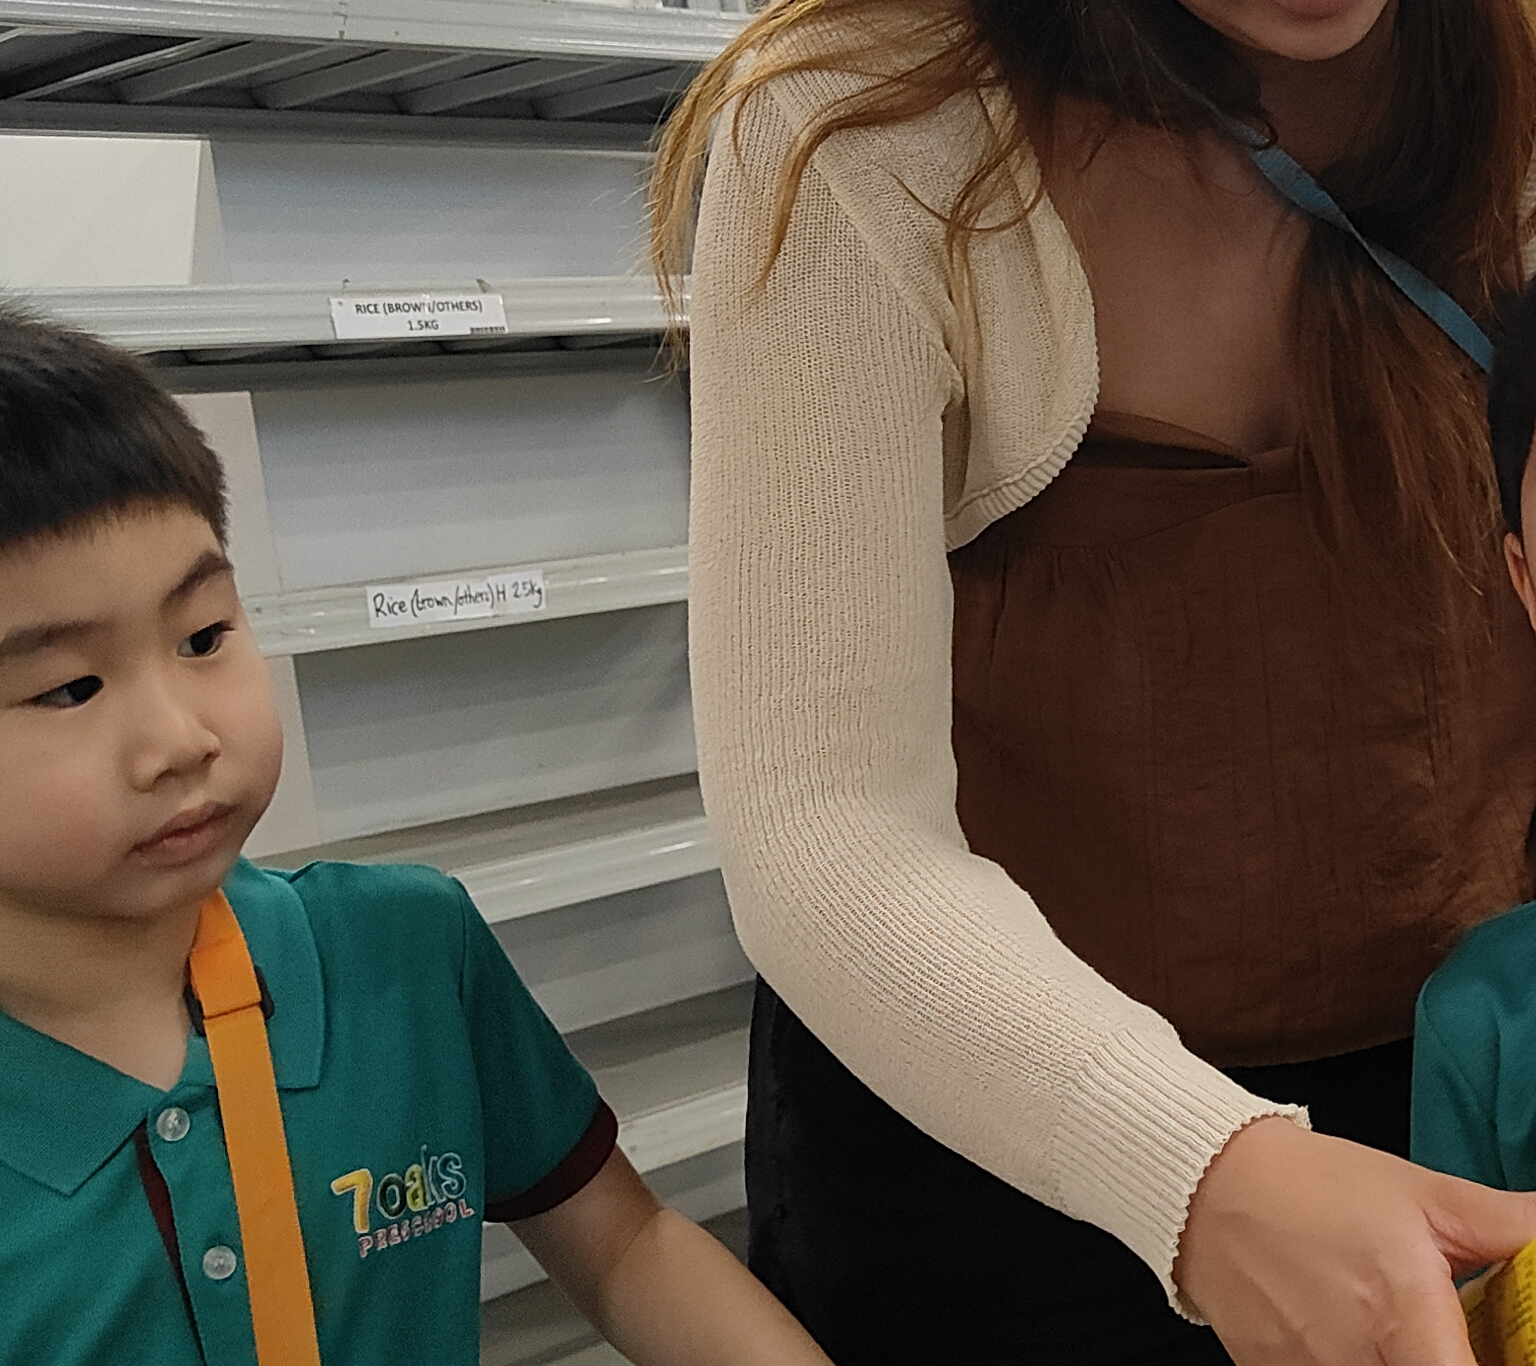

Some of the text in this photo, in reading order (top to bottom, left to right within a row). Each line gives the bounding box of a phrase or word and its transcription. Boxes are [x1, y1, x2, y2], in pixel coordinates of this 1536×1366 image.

[355, 303, 380, 315] RICE
[408, 320, 439, 331] 1.5KG
[373, 592, 408, 618] Rice
[358, 1199, 475, 1258] PRESCHOOL
